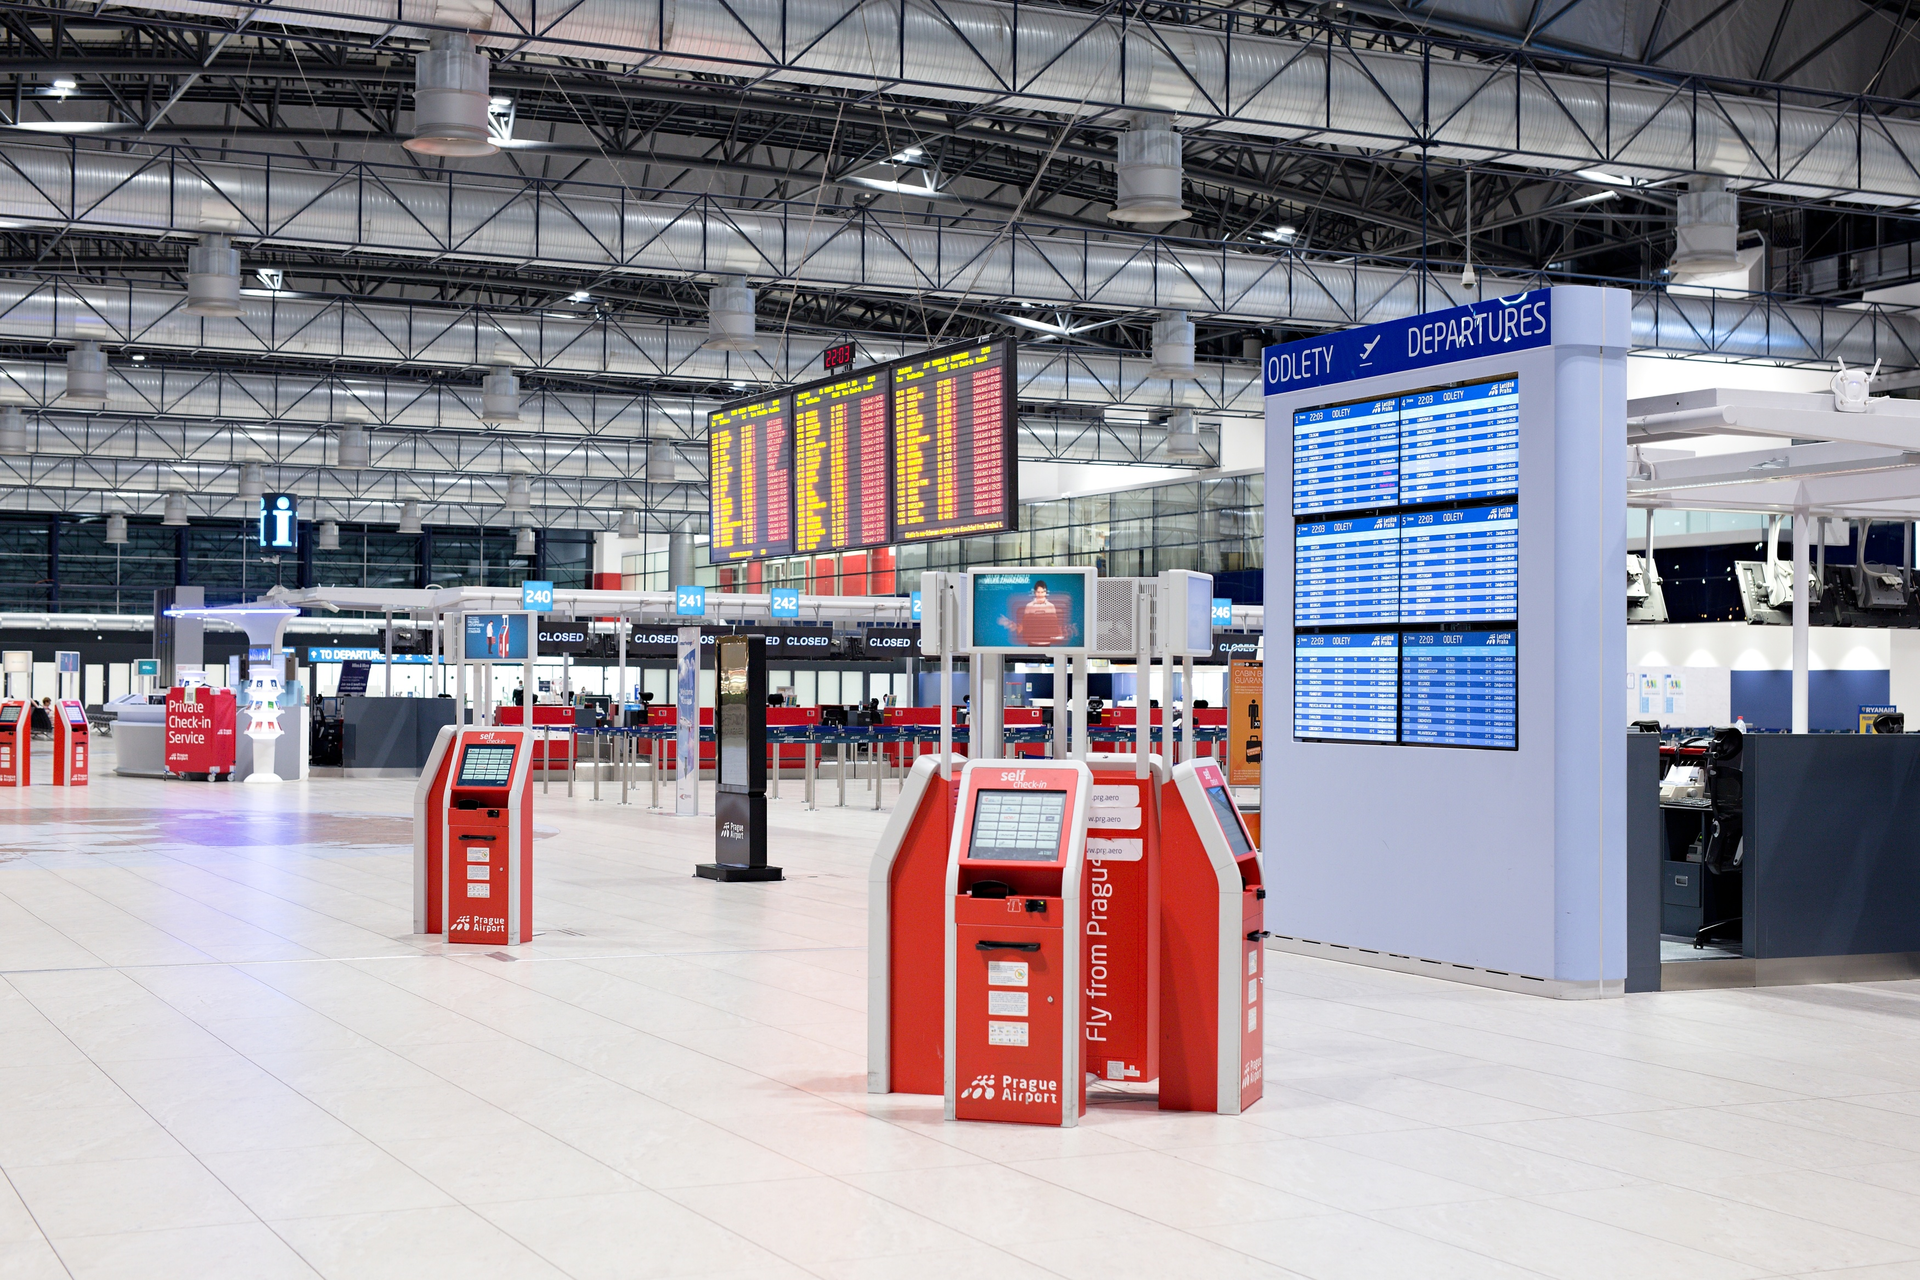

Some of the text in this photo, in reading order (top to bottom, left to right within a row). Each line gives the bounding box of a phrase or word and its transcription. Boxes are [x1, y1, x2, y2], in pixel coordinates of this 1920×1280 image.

[1268, 301, 1546, 384] ODLETY DEPARTURES
[826, 345, 850, 367] 22:03
[1418, 395, 1433, 405] 22:03
[1443, 390, 1464, 401] ODLETY
[1310, 412, 1323, 421] 22:03
[1332, 408, 1351, 418] ODLETY
[1402, 517, 1406, 525] 5
[1418, 515, 1433, 524] 22:03
[1443, 512, 1464, 522] ODLETY
[1311, 525, 1325, 534] 22:03
[1334, 522, 1352, 531] ODLETY
[526, 590, 551, 603] 240
[679, 595, 701, 607] 241
[773, 597, 796, 610] 242
[1211, 607, 1230, 618] 246
[538, 632, 584, 642] CLOSED
[635, 634, 678, 644] CLOSED
[787, 637, 828, 646] CLOSED
[1311, 637, 1324, 645] 22:03
[1332, 637, 1351, 645] ODLETY
[1404, 636, 1407, 644] 6
[1419, 635, 1434, 644] 22:03
[1443, 635, 1463, 643] ODLETY
[870, 638, 910, 647] CLOSED
[320, 650, 332, 659] TO
[169, 700, 204, 713] Private
[169, 716, 211, 728] Check-in
[169, 731, 204, 744] Service
[1001, 770, 1026, 781] self
[1013, 780, 1047, 788] check-in
[731, 822, 743, 832] Prague
[474, 916, 505, 925] Prague
[473, 924, 505, 933] Airport
[1086, 945, 1107, 997] from
[1086, 1006, 1112, 1041] Fly
[1003, 1075, 1057, 1092] Prague
[1002, 1088, 1057, 1104] Airport
